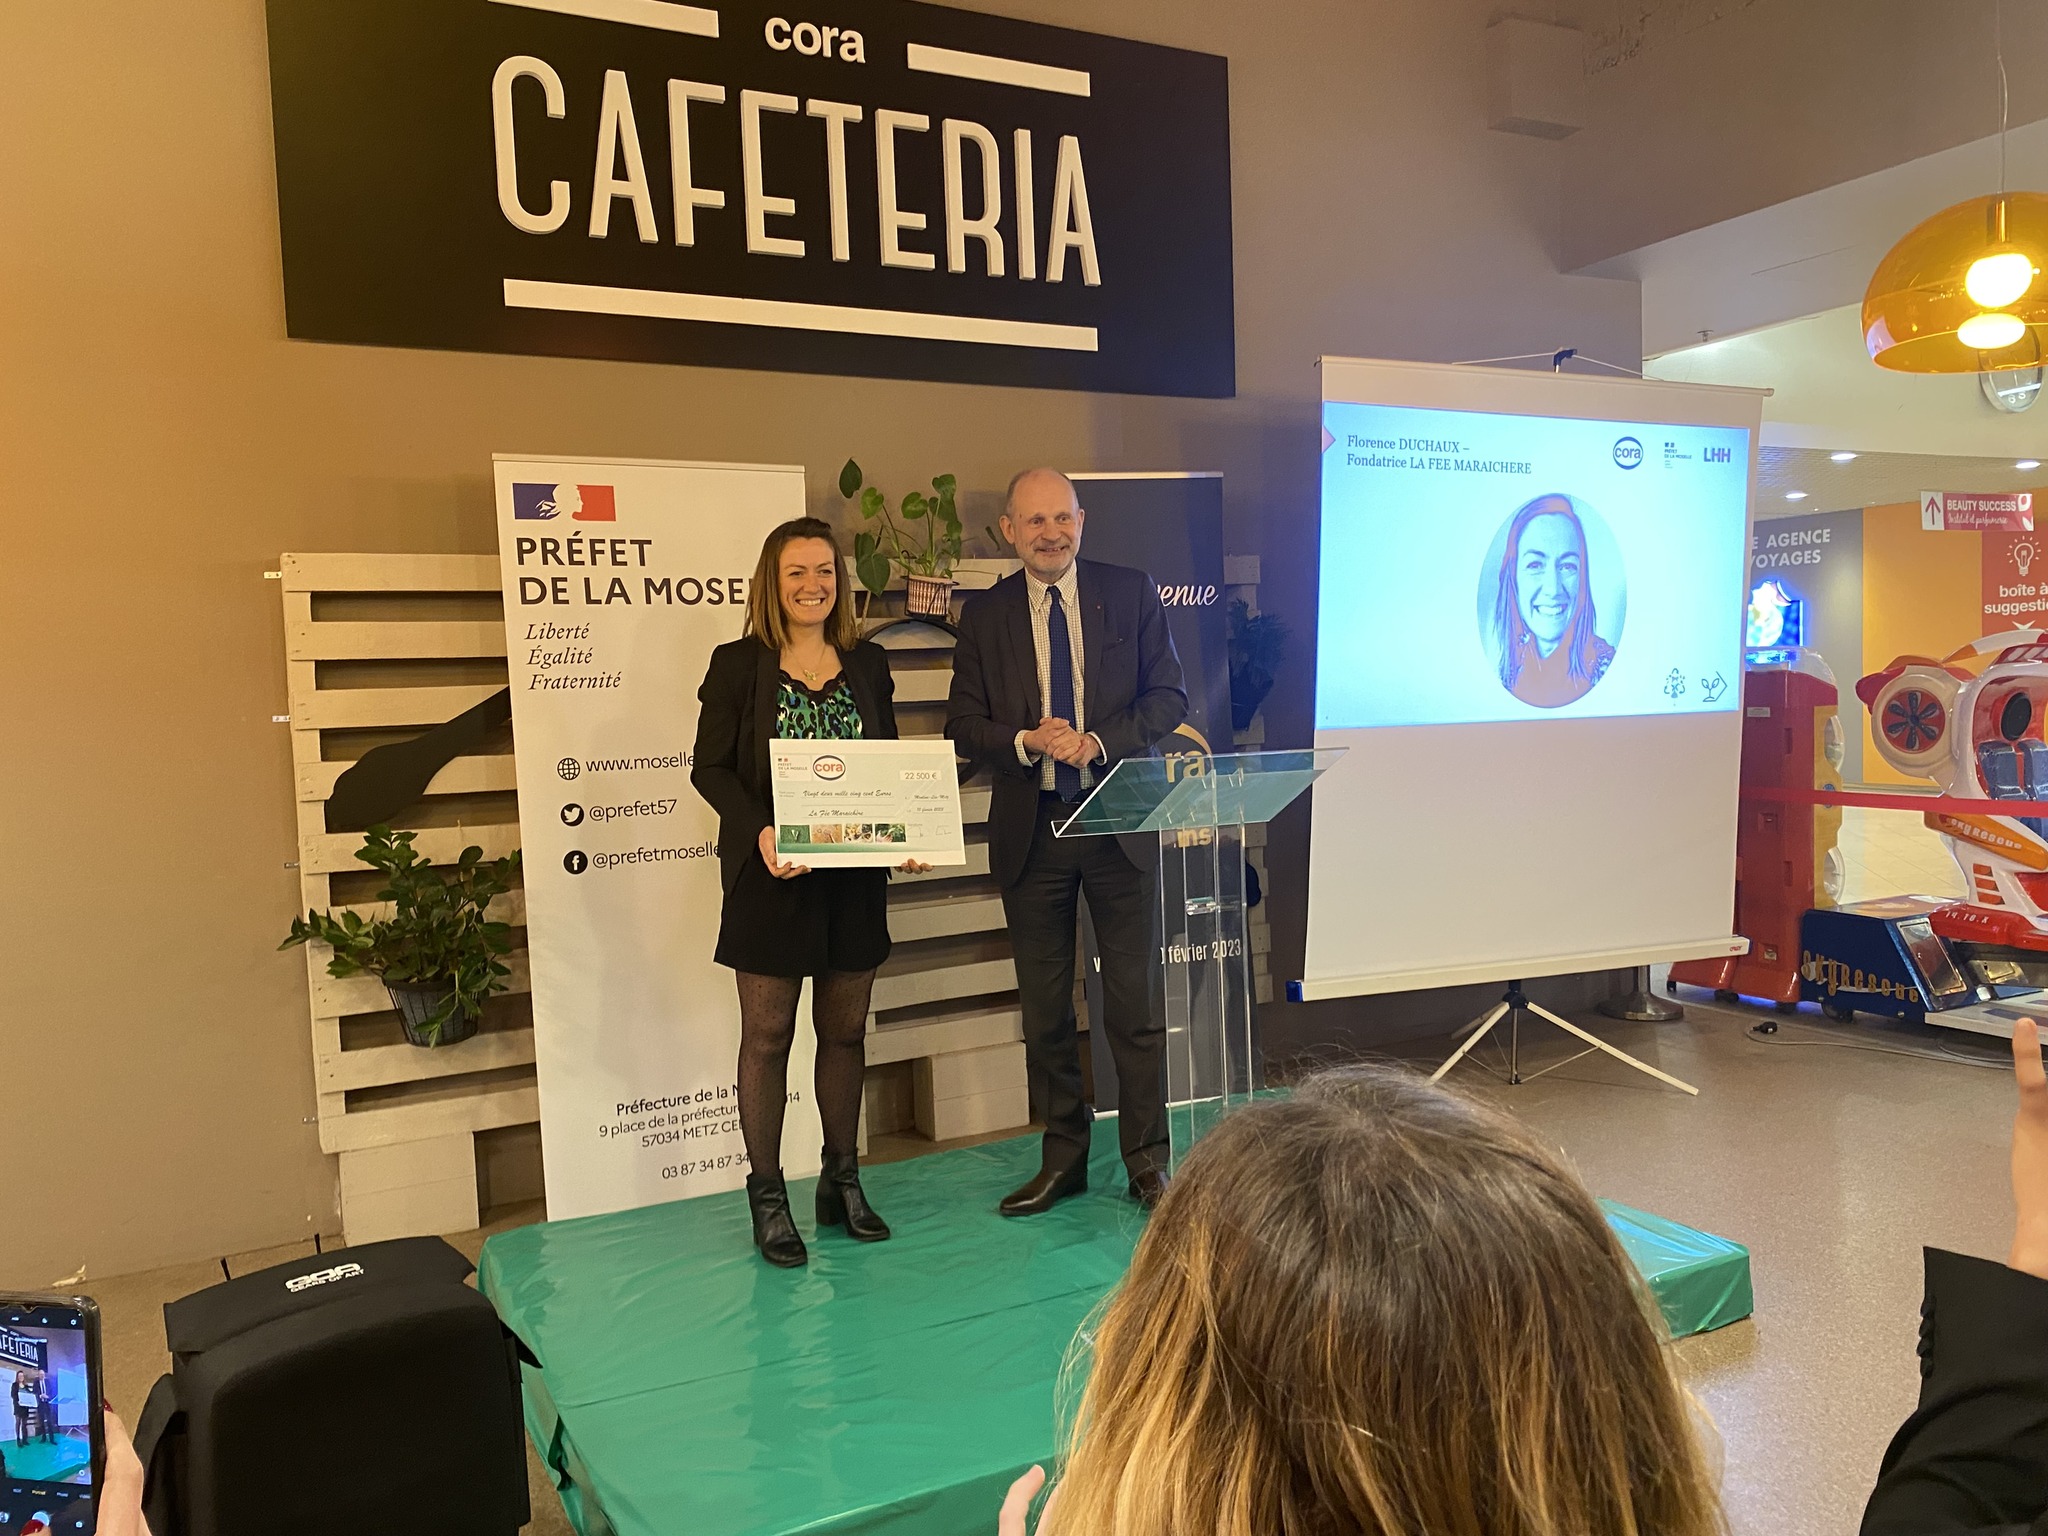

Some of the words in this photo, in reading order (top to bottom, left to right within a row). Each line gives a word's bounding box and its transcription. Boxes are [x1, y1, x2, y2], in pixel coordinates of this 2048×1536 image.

[764, 16, 866, 64] cora
[491, 55, 1102, 288] CAFETERIA
[1347, 435, 1396, 450] Florence
[1399, 438, 1460, 453] DUCHAUX
[1614, 447, 1641, 459] cora
[1347, 453, 1407, 468] Fondatrice
[1410, 457, 1425, 469] LA
[1428, 458, 1451, 471] FEE
[1454, 460, 1532, 474] MARAICHERE
[1703, 447, 1731, 463] LHH
[1947, 500, 1977, 511] BEAUTY
[1978, 501, 2016, 512] SUCCESS
[1766, 528, 1831, 548] AGENCE
[516, 530, 653, 567] PRÉFET
[519, 576, 570, 605] DE
[583, 577, 632, 605] LA
[644, 577, 753, 606] MOSE
[1999, 583, 2036, 598] boîte
[2040, 582, 2048, 596] à
[1984, 598, 2048, 616] suggesti
[524, 622, 591, 640] Liberté
[526, 645, 594, 670] Égalité
[528, 671, 623, 691] Fraternité
[815, 763, 843, 772] cora
[904, 772, 915, 780] 22
[916, 772, 930, 780] 500
[931, 772, 937, 780] €
[803, 790, 819, 798] Vingt
[875, 789, 892, 797] Euros
[589, 799, 678, 823] @prefet57
[1167, 943, 1208, 964] février
[1212, 938, 1241, 959] 2023
[616, 1094, 691, 1116] Préfecture
[694, 1088, 713, 1103] de
[716, 1086, 728, 1099] la
[599, 1125, 608, 1138] 9
[611, 1121, 645, 1139] place
[648, 1116, 665, 1129] de
[668, 1113, 678, 1125] la
[642, 1130, 680, 1148] 57034
[683, 1123, 719, 1140] METZ
[662, 1165, 678, 1179] 03
[680, 1162, 696, 1176] 87
[699, 1158, 714, 1172] 34
[717, 1155, 732, 1169] 87
[735, 1151, 750, 1166] 34
[345, 1268, 364, 1278] ART
